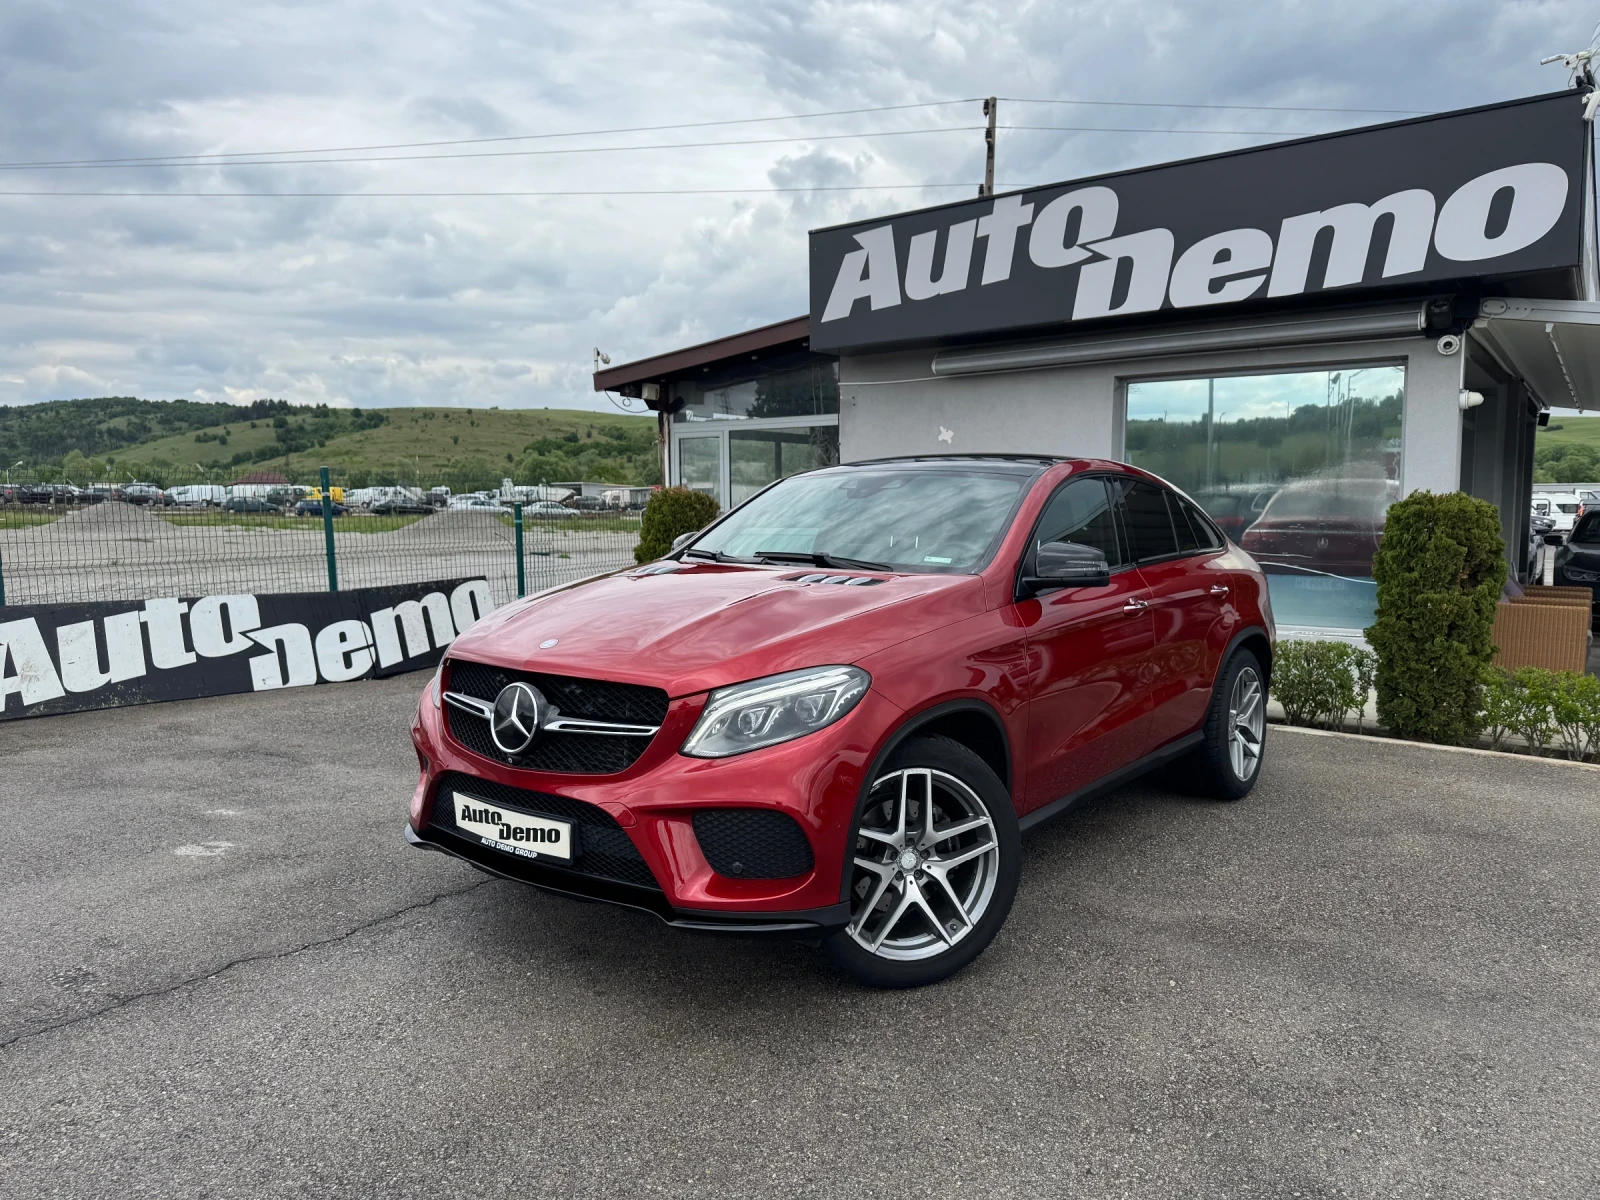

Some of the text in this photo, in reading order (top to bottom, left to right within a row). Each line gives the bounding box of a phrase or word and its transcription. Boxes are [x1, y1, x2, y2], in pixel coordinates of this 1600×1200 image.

[821, 162, 1569, 323] Auto Demo
[0, 580, 496, 712] Auto Demo
[461, 804, 561, 843] Auto Demo
[480, 837, 538, 858] AUTO DEMO GROUP
